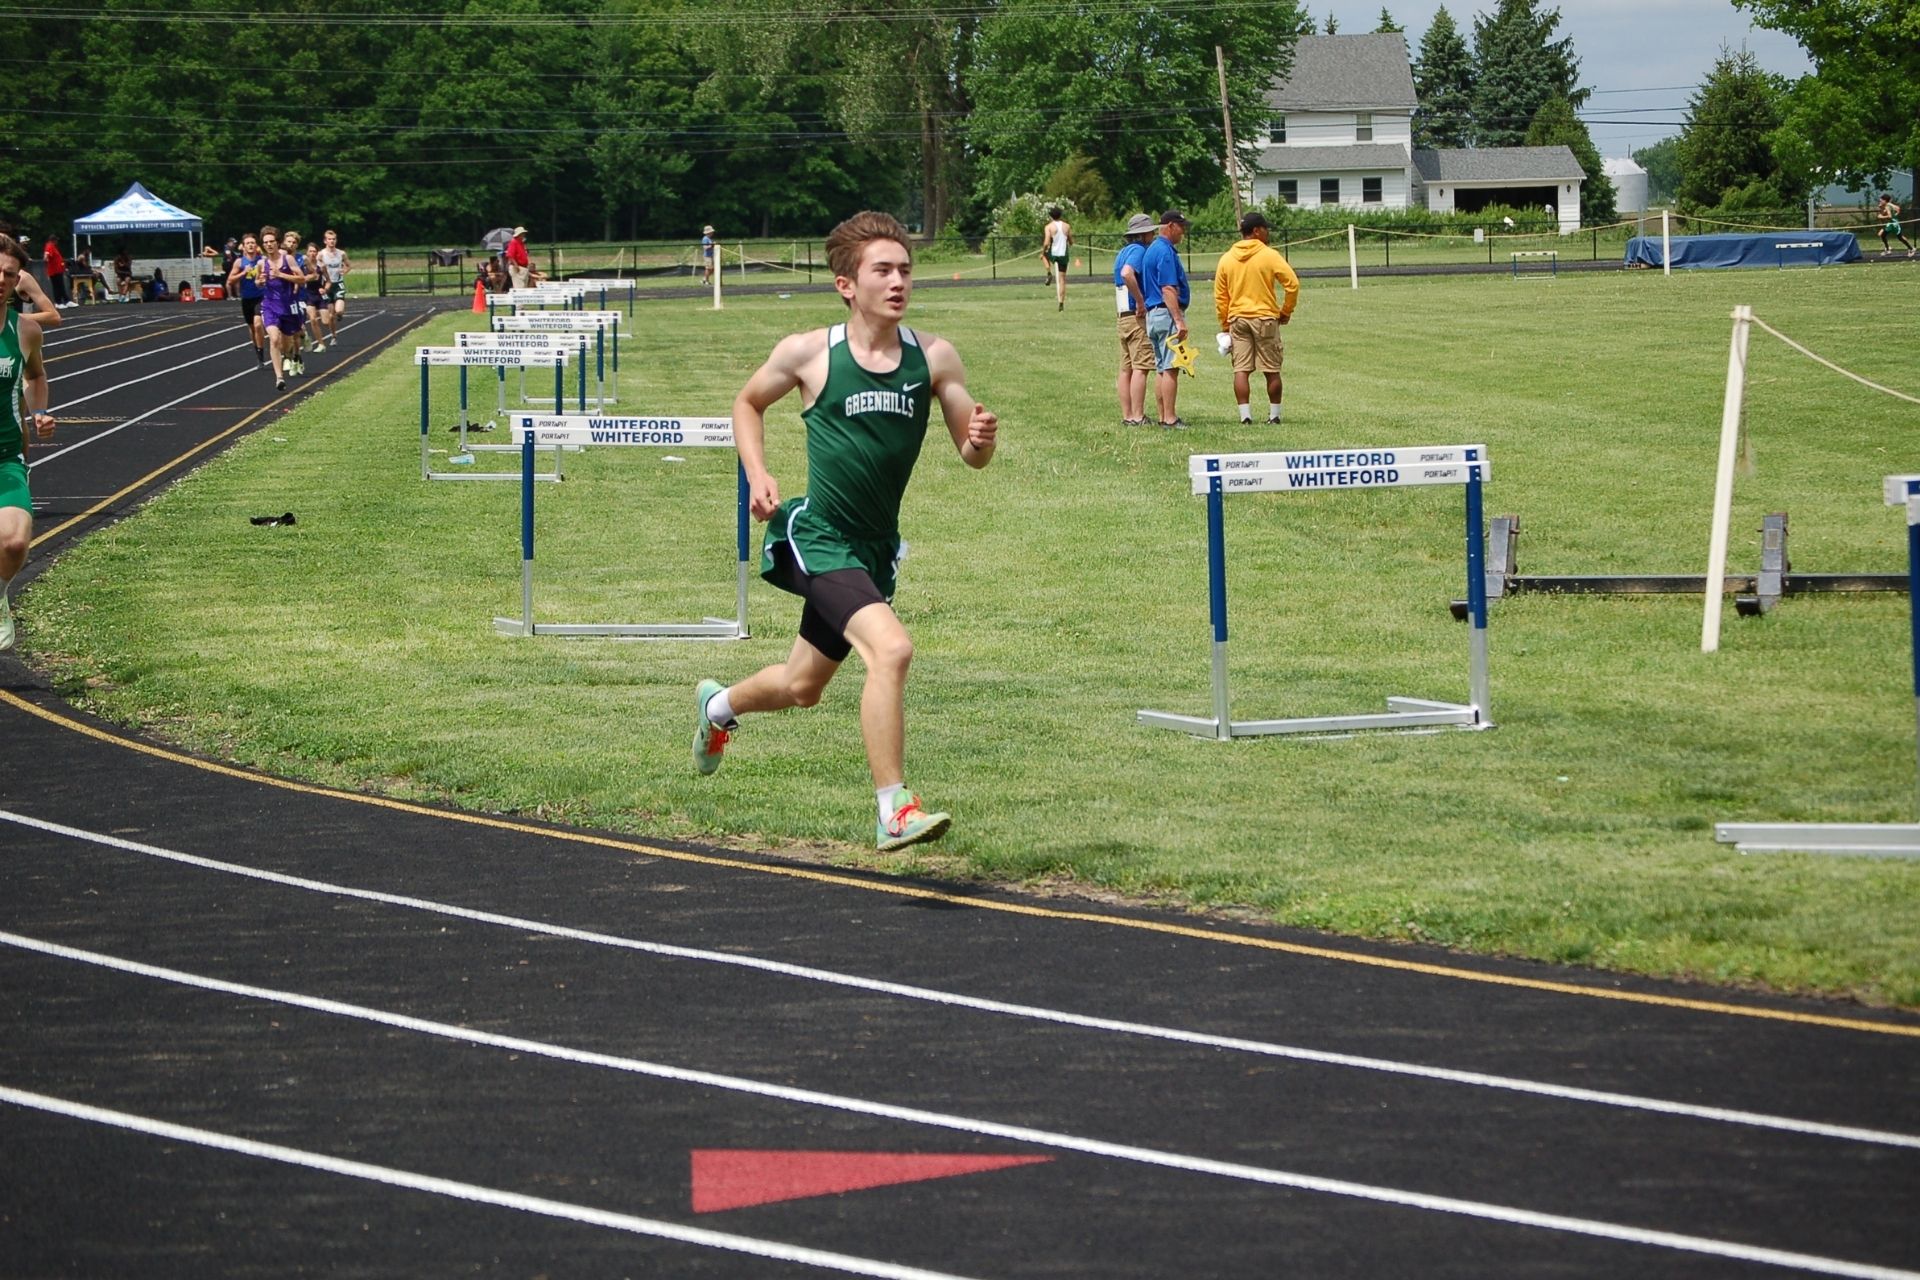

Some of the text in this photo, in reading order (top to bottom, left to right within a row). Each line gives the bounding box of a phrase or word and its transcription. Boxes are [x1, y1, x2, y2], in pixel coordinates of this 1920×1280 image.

[845, 390, 914, 418] GREENHILLS
[588, 419, 681, 430] WHITEFORD
[591, 431, 684, 444] WHITEFORD
[1285, 452, 1396, 470] WHITEFORD
[1289, 469, 1399, 488] WHITEFORD
